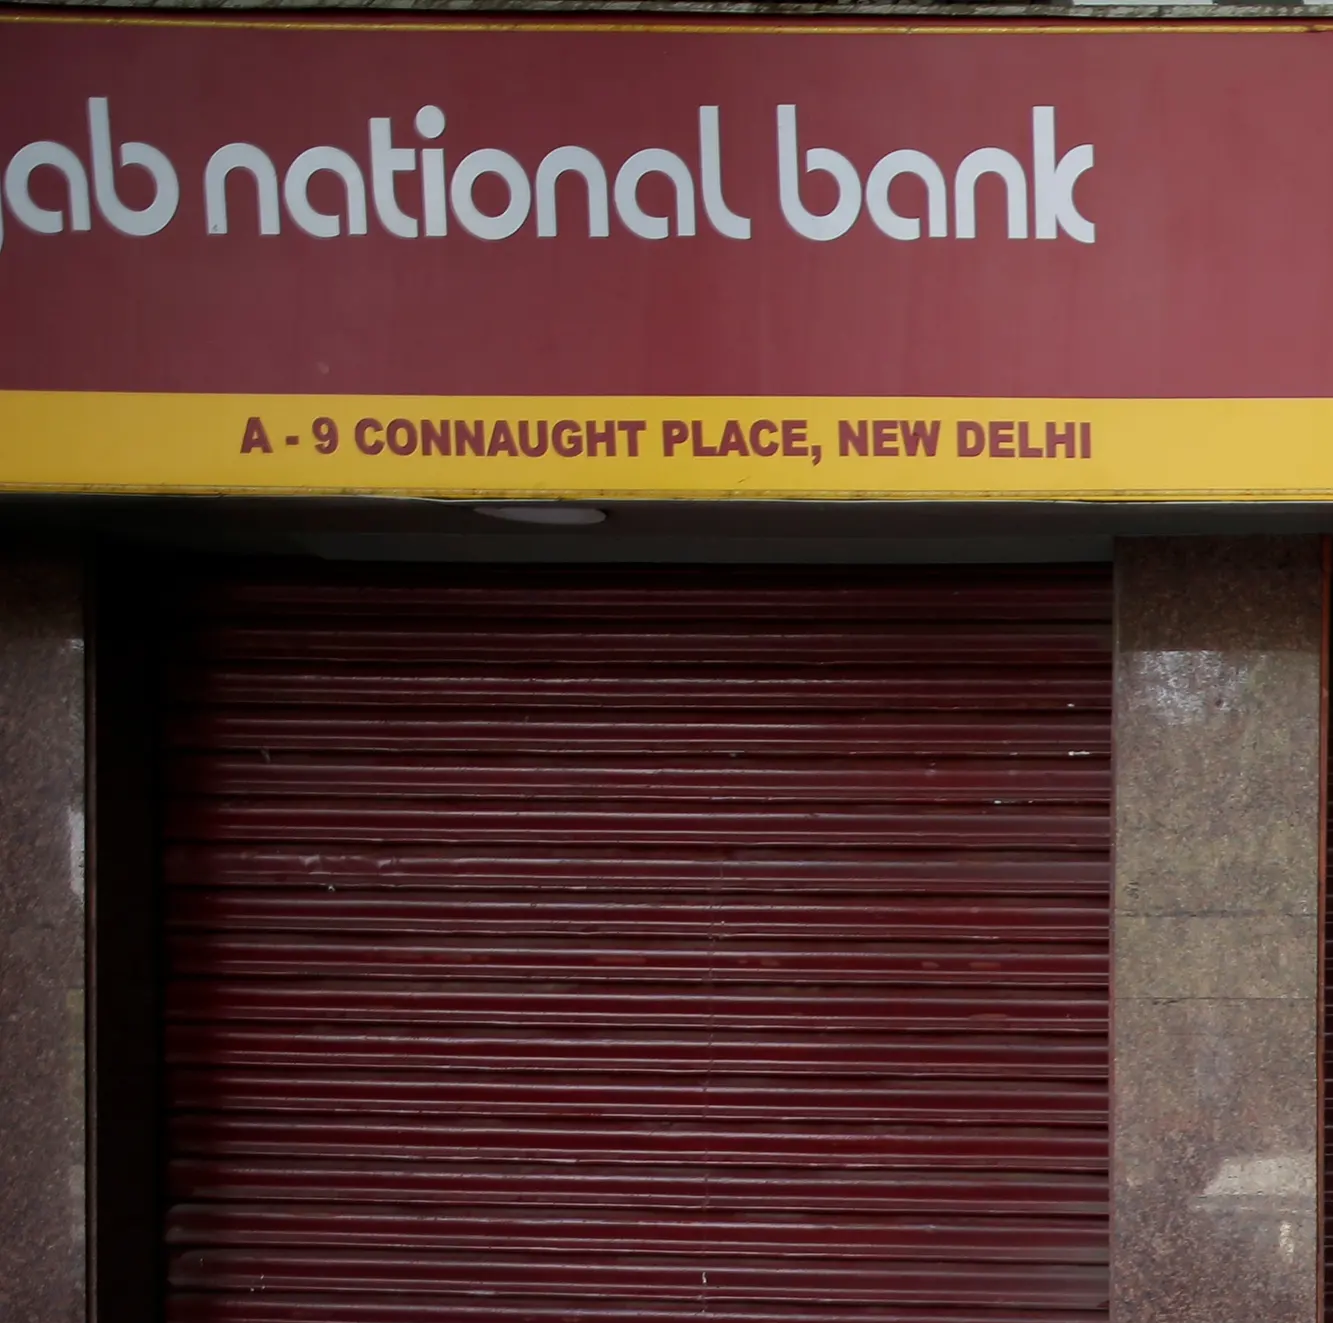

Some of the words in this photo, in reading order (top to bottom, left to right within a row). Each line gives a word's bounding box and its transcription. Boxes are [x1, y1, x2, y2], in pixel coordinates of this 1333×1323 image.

[0, 96, 180, 253] ab
[206, 106, 750, 239] national
[777, 105, 1095, 243] bank
[240, 417, 273, 453] A
[286, 436, 299, 445] -
[312, 417, 338, 454] 9
[355, 418, 646, 457] CONNAUGHT
[663, 420, 821, 465] PLACE,
[839, 420, 940, 456] NEW
[958, 422, 1090, 458] DELHI
